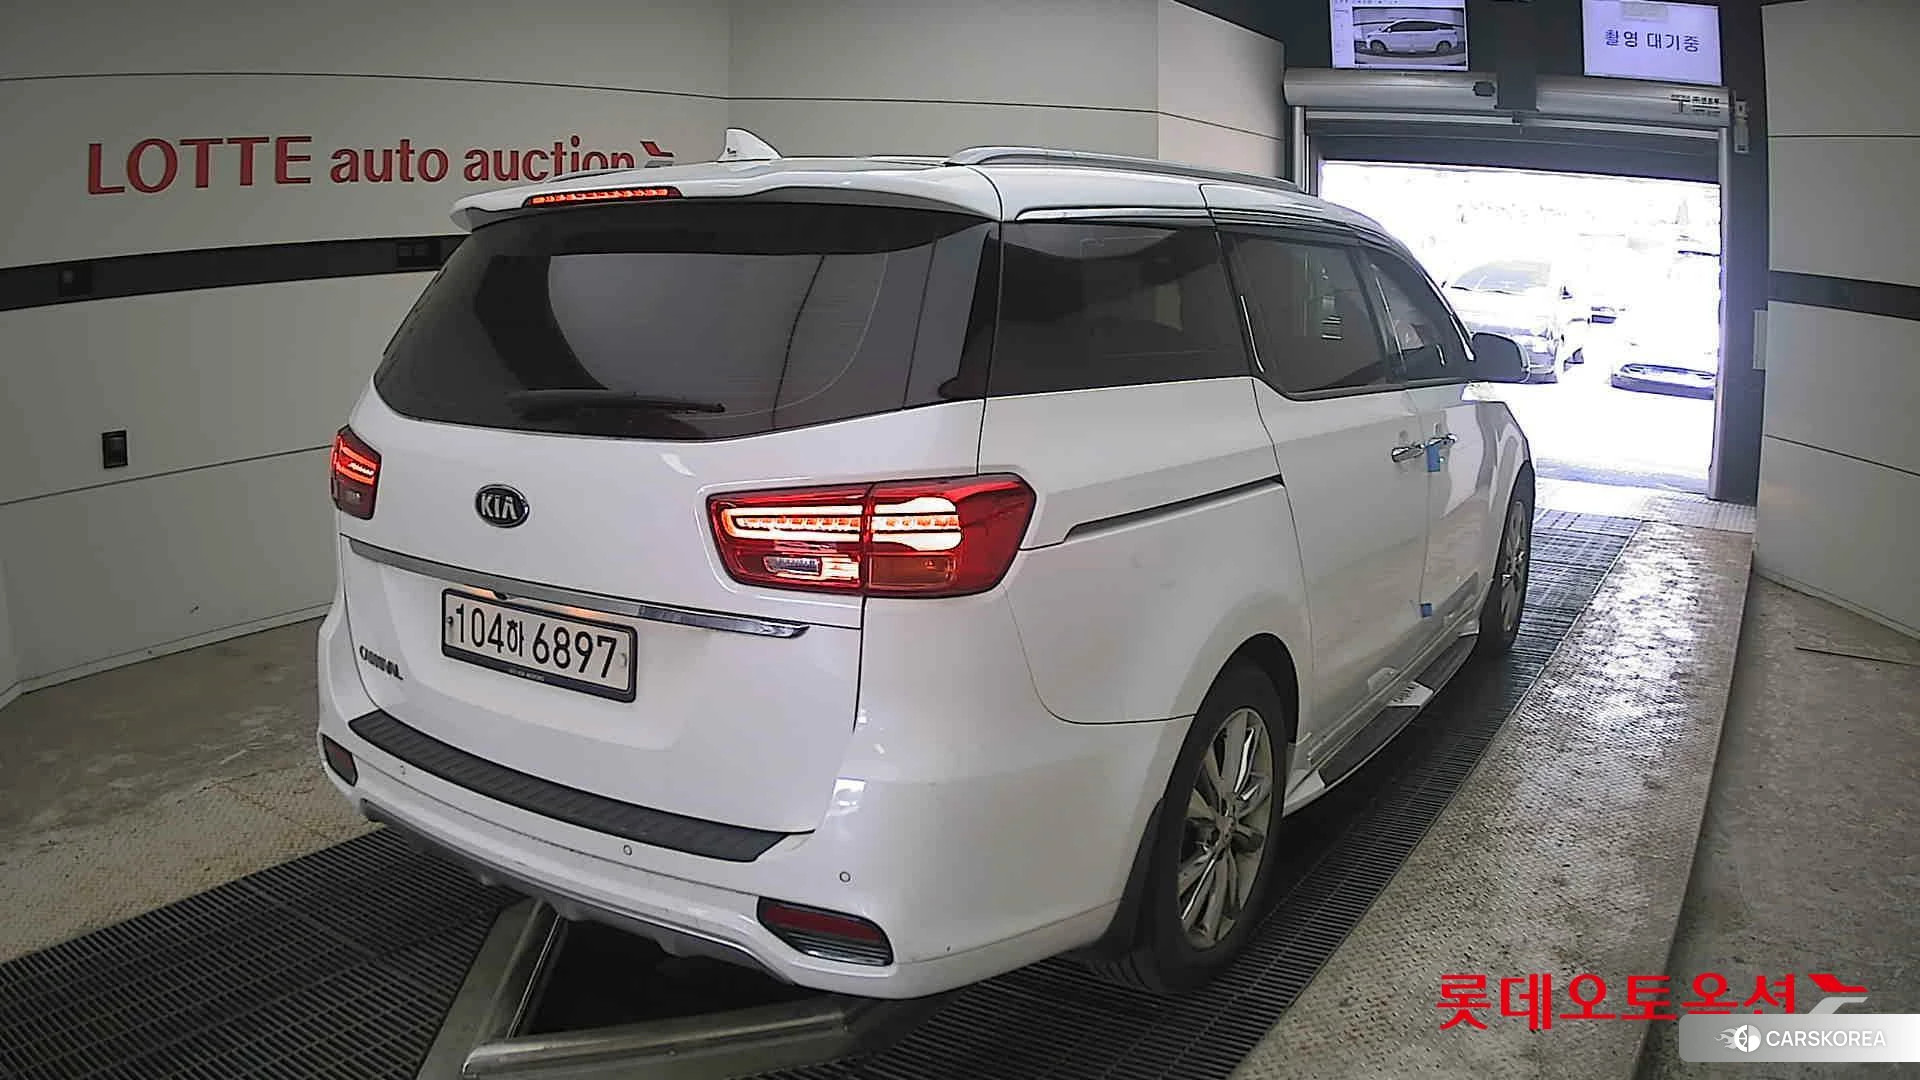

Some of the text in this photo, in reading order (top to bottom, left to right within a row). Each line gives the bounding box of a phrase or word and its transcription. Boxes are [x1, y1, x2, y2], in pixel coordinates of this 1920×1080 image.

[1646, 32, 1700, 52] 대기중
[88, 134, 636, 194] LOTTE auto auction
[480, 492, 518, 520] KIA
[531, 622, 617, 678] 6897
